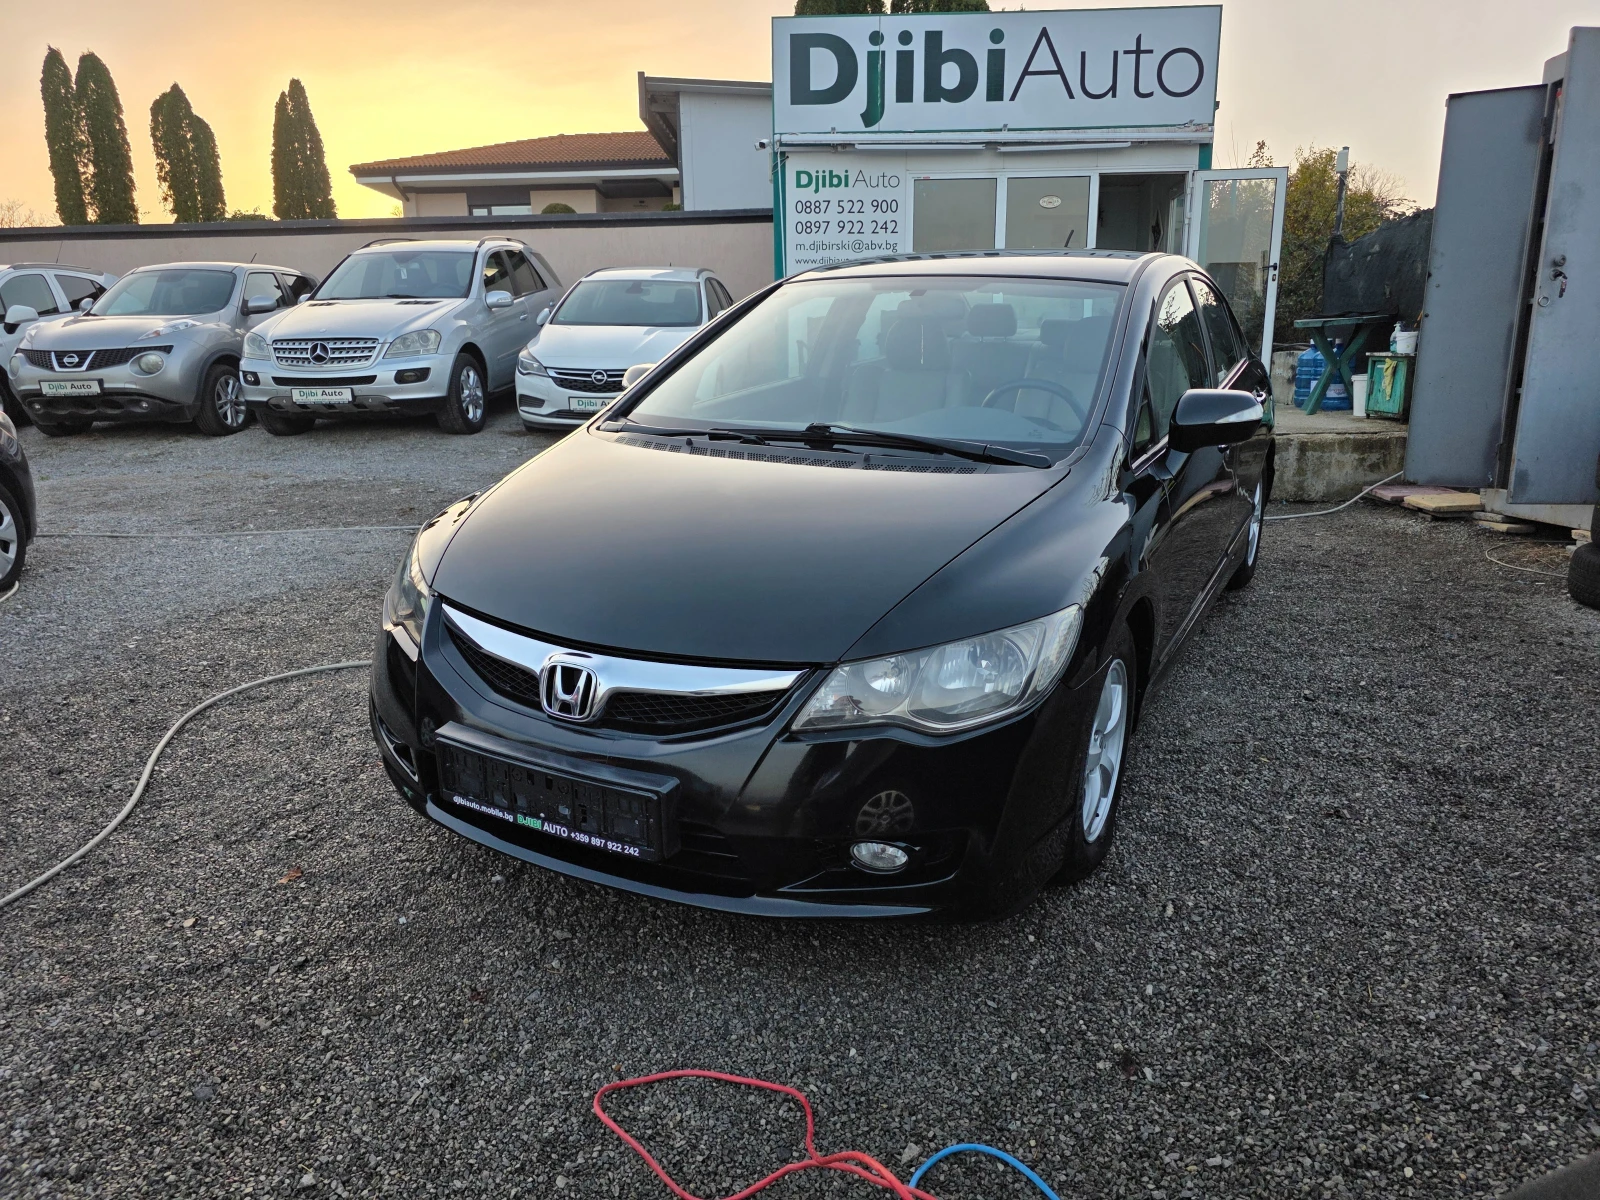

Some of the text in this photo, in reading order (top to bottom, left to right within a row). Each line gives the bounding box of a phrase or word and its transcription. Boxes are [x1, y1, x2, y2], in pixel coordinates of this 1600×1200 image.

[795, 169, 900, 194] Djibi Auto
[795, 199, 899, 214] 0887 522 900
[795, 220, 899, 234] 0897 922 242
[795, 239, 898, 253] m.djibirski@abv.bg
[577, 399, 598, 408] Djibi
[453, 795, 640, 857] djibiauto.mobile.bg DJIBI AUTO +359 897 922 242
